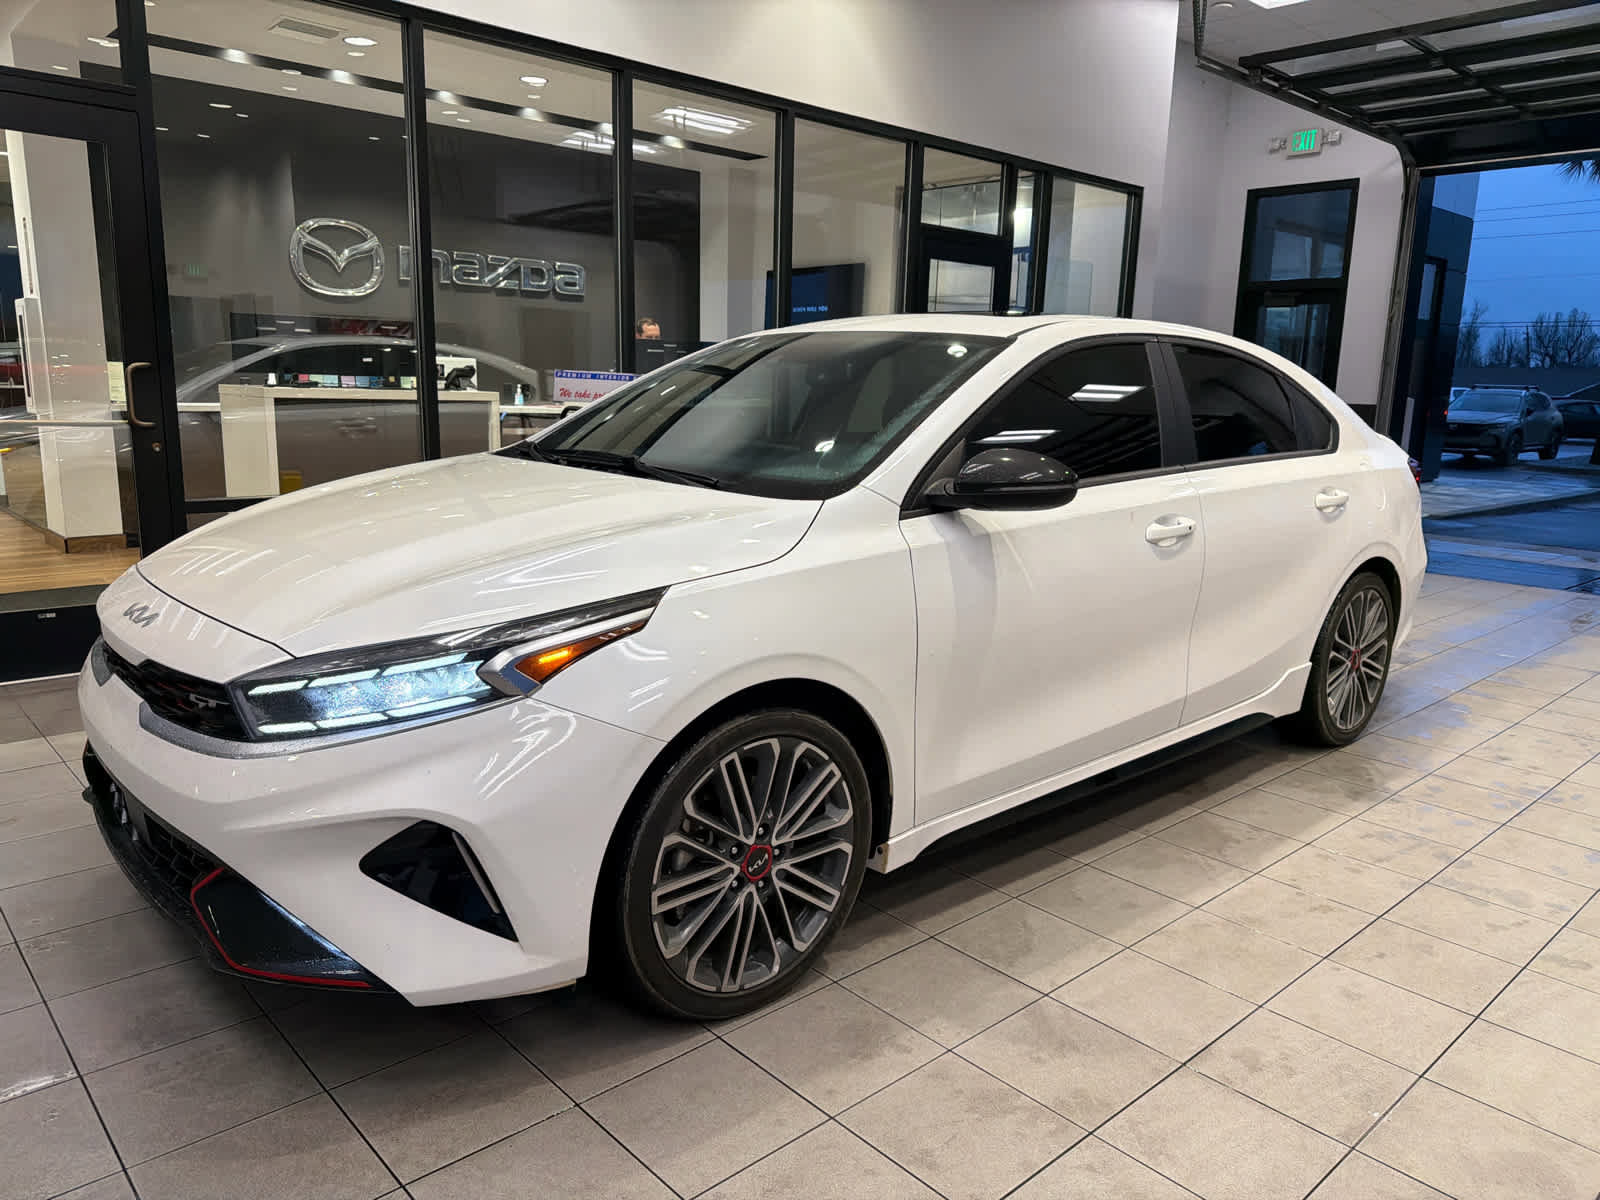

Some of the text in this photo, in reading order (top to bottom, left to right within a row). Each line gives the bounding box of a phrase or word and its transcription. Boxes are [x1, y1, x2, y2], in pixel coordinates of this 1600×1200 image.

[1291, 129, 1318, 152] EXIT
[557, 371, 592, 379] PREMIUM
[596, 373, 630, 381] INTERIOR
[123, 602, 160, 628] KIA
